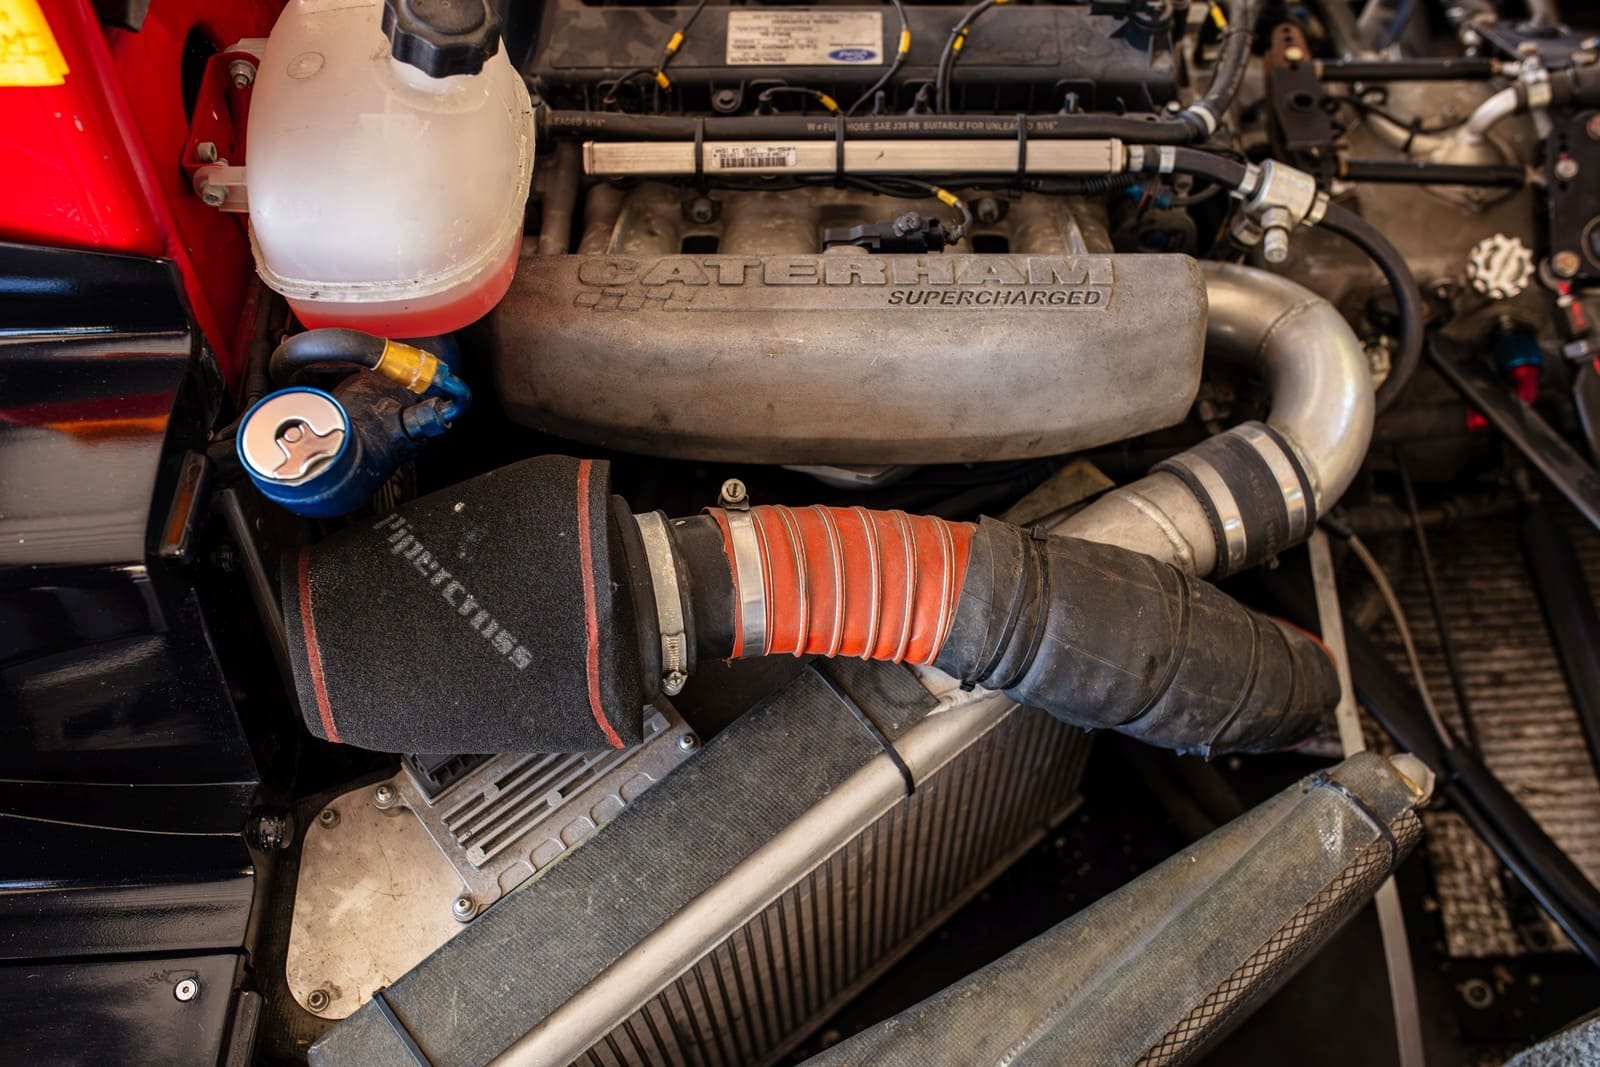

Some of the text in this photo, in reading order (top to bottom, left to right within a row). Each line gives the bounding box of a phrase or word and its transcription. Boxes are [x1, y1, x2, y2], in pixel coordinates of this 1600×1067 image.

[847, 121, 872, 132] HOSE
[874, 120, 892, 131] SAE
[923, 120, 964, 130] SUITABLE
[966, 120, 985, 130] FOR
[986, 120, 1034, 130] UNLEAD
[577, 256, 1115, 287] CATERHAM
[887, 289, 1102, 306] SUPERCHARGED
